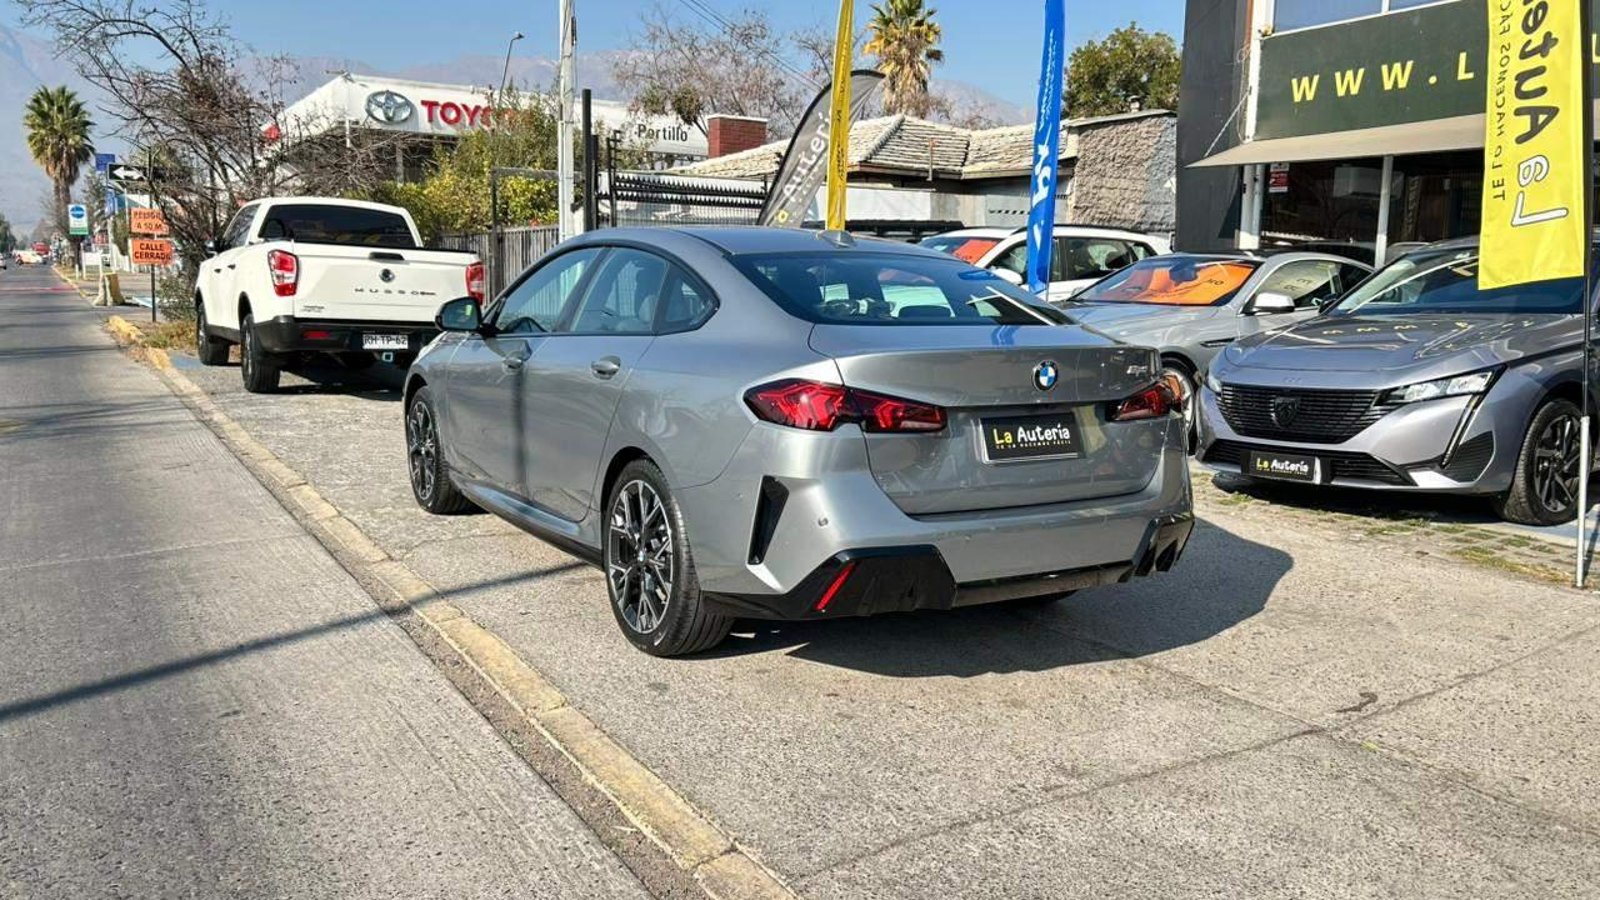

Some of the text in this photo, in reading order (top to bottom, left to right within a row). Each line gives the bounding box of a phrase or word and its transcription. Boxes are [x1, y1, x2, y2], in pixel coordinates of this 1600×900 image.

[638, 124, 688, 141] Portillo
[140, 243, 165, 251] CALLE
[993, 422, 1070, 444] La Autería
